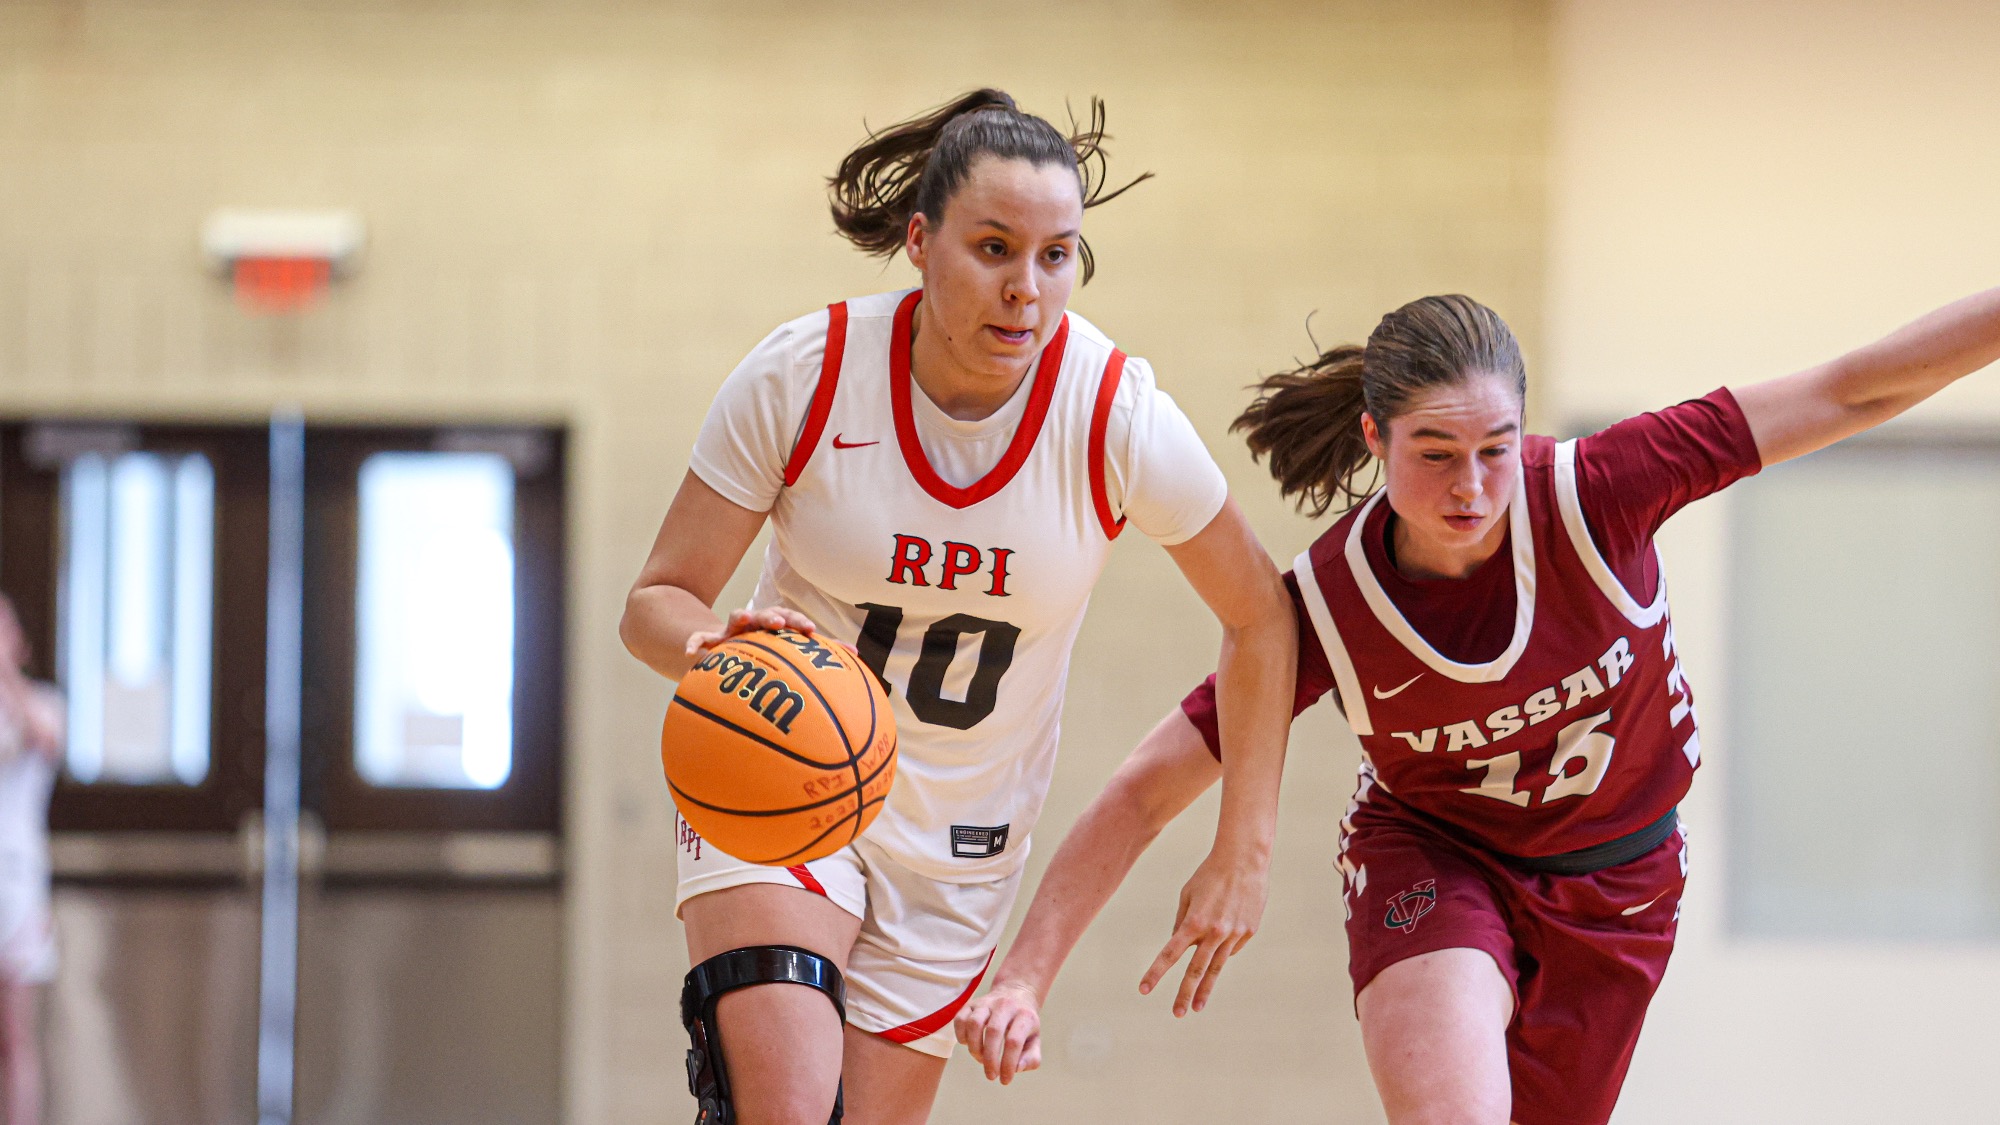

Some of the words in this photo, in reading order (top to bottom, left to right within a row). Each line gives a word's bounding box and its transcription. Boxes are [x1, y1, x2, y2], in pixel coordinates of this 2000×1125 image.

[886, 533, 1016, 597] RPI
[855, 602, 1022, 731] 10
[1390, 636, 1635, 753] VASSAR
[680, 819, 702, 861] RPI
[993, 834, 1003, 848] M
